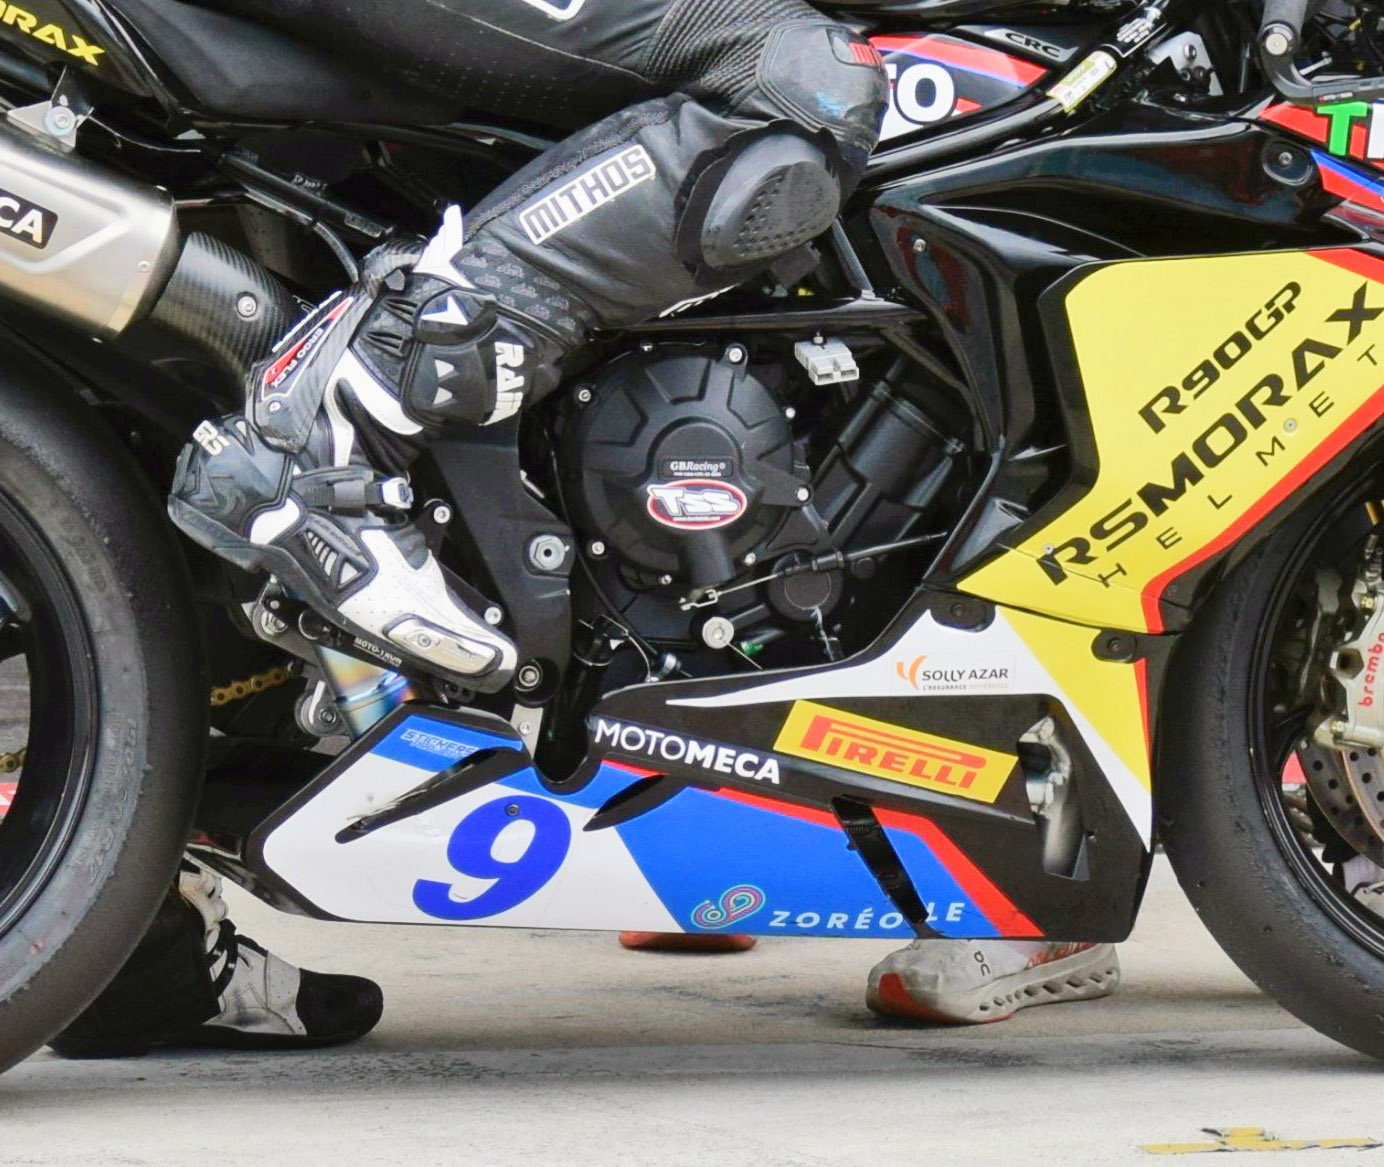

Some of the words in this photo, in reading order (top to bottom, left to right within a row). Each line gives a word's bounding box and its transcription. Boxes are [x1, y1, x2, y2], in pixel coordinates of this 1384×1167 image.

[1005, 32, 1062, 58] CRC
[525, 149, 654, 237] MITHOS
[1138, 282, 1304, 435] R90GP
[649, 485, 741, 516] TSS
[1097, 345, 1383, 589] HELMET
[922, 670, 966, 682] SOLLY
[968, 668, 1009, 680] AZAR
[595, 715, 781, 785] MOTOMECA
[808, 715, 987, 791] PIRELLI
[411, 794, 572, 920] 9
[769, 901, 966, 930] ZORÉOLE
